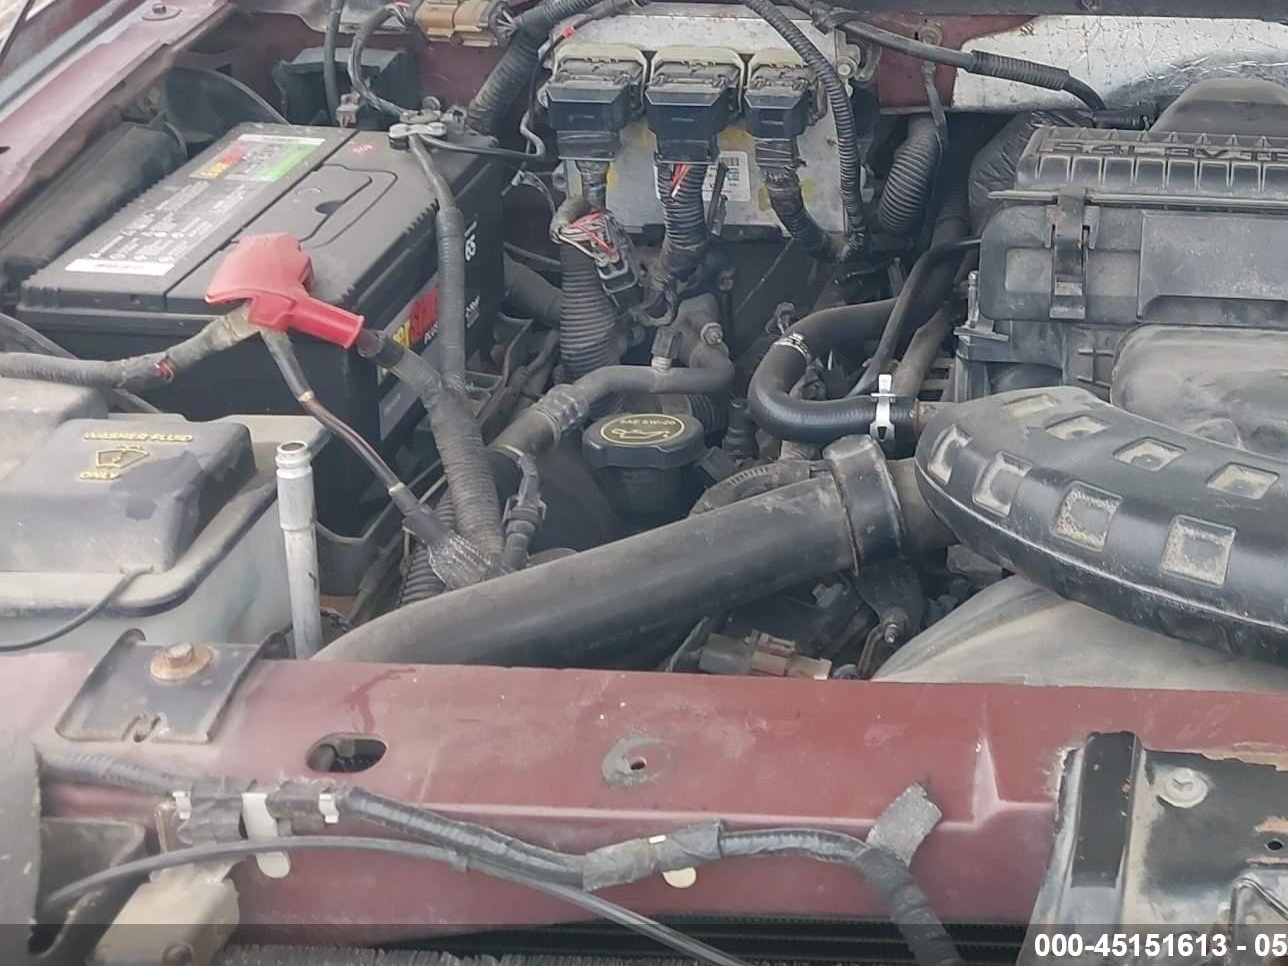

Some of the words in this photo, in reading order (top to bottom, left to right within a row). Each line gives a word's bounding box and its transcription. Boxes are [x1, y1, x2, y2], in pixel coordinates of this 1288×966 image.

[83, 432, 148, 442] WASHER
[150, 433, 193, 442] FLUID
[79, 471, 122, 480] ONLY
